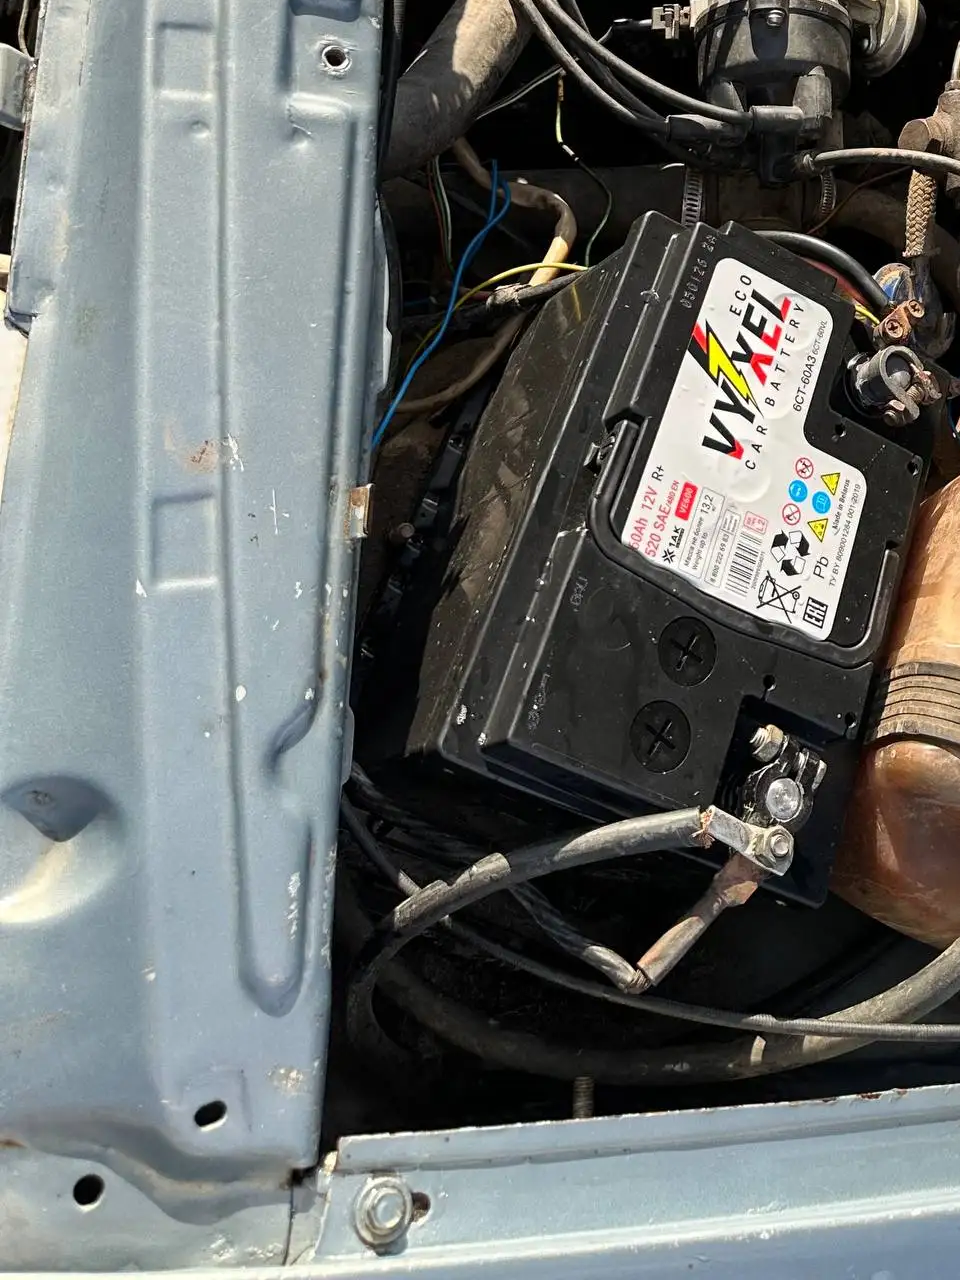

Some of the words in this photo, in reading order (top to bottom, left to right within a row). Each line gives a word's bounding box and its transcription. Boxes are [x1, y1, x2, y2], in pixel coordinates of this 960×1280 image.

[729, 275, 752, 316] ECO
[702, 290, 792, 459] VYXEL
[745, 425, 767, 470] CAR
[764, 303, 804, 407] BATTERY
[628, 517, 648, 551] 60Ah
[641, 485, 657, 510] 12V
[651, 465, 664, 482] R+
[679, 487, 694, 514] VE600
[700, 494, 714, 514] 13,2
[832, 511, 841, 530] Made
[839, 479, 850, 503] Belarus
[645, 533, 661, 557] 520
[671, 480, 679, 491] EN
[693, 517, 704, 536] более
[691, 537, 697, 545] не
[715, 552, 723, 565] 222
[719, 543, 726, 552] 69
[684, 545, 695, 567] Масса
[692, 549, 702, 570] Weight
[699, 540, 706, 549] up
[813, 556, 829, 579] Pb
[832, 562, 840, 575] BY
